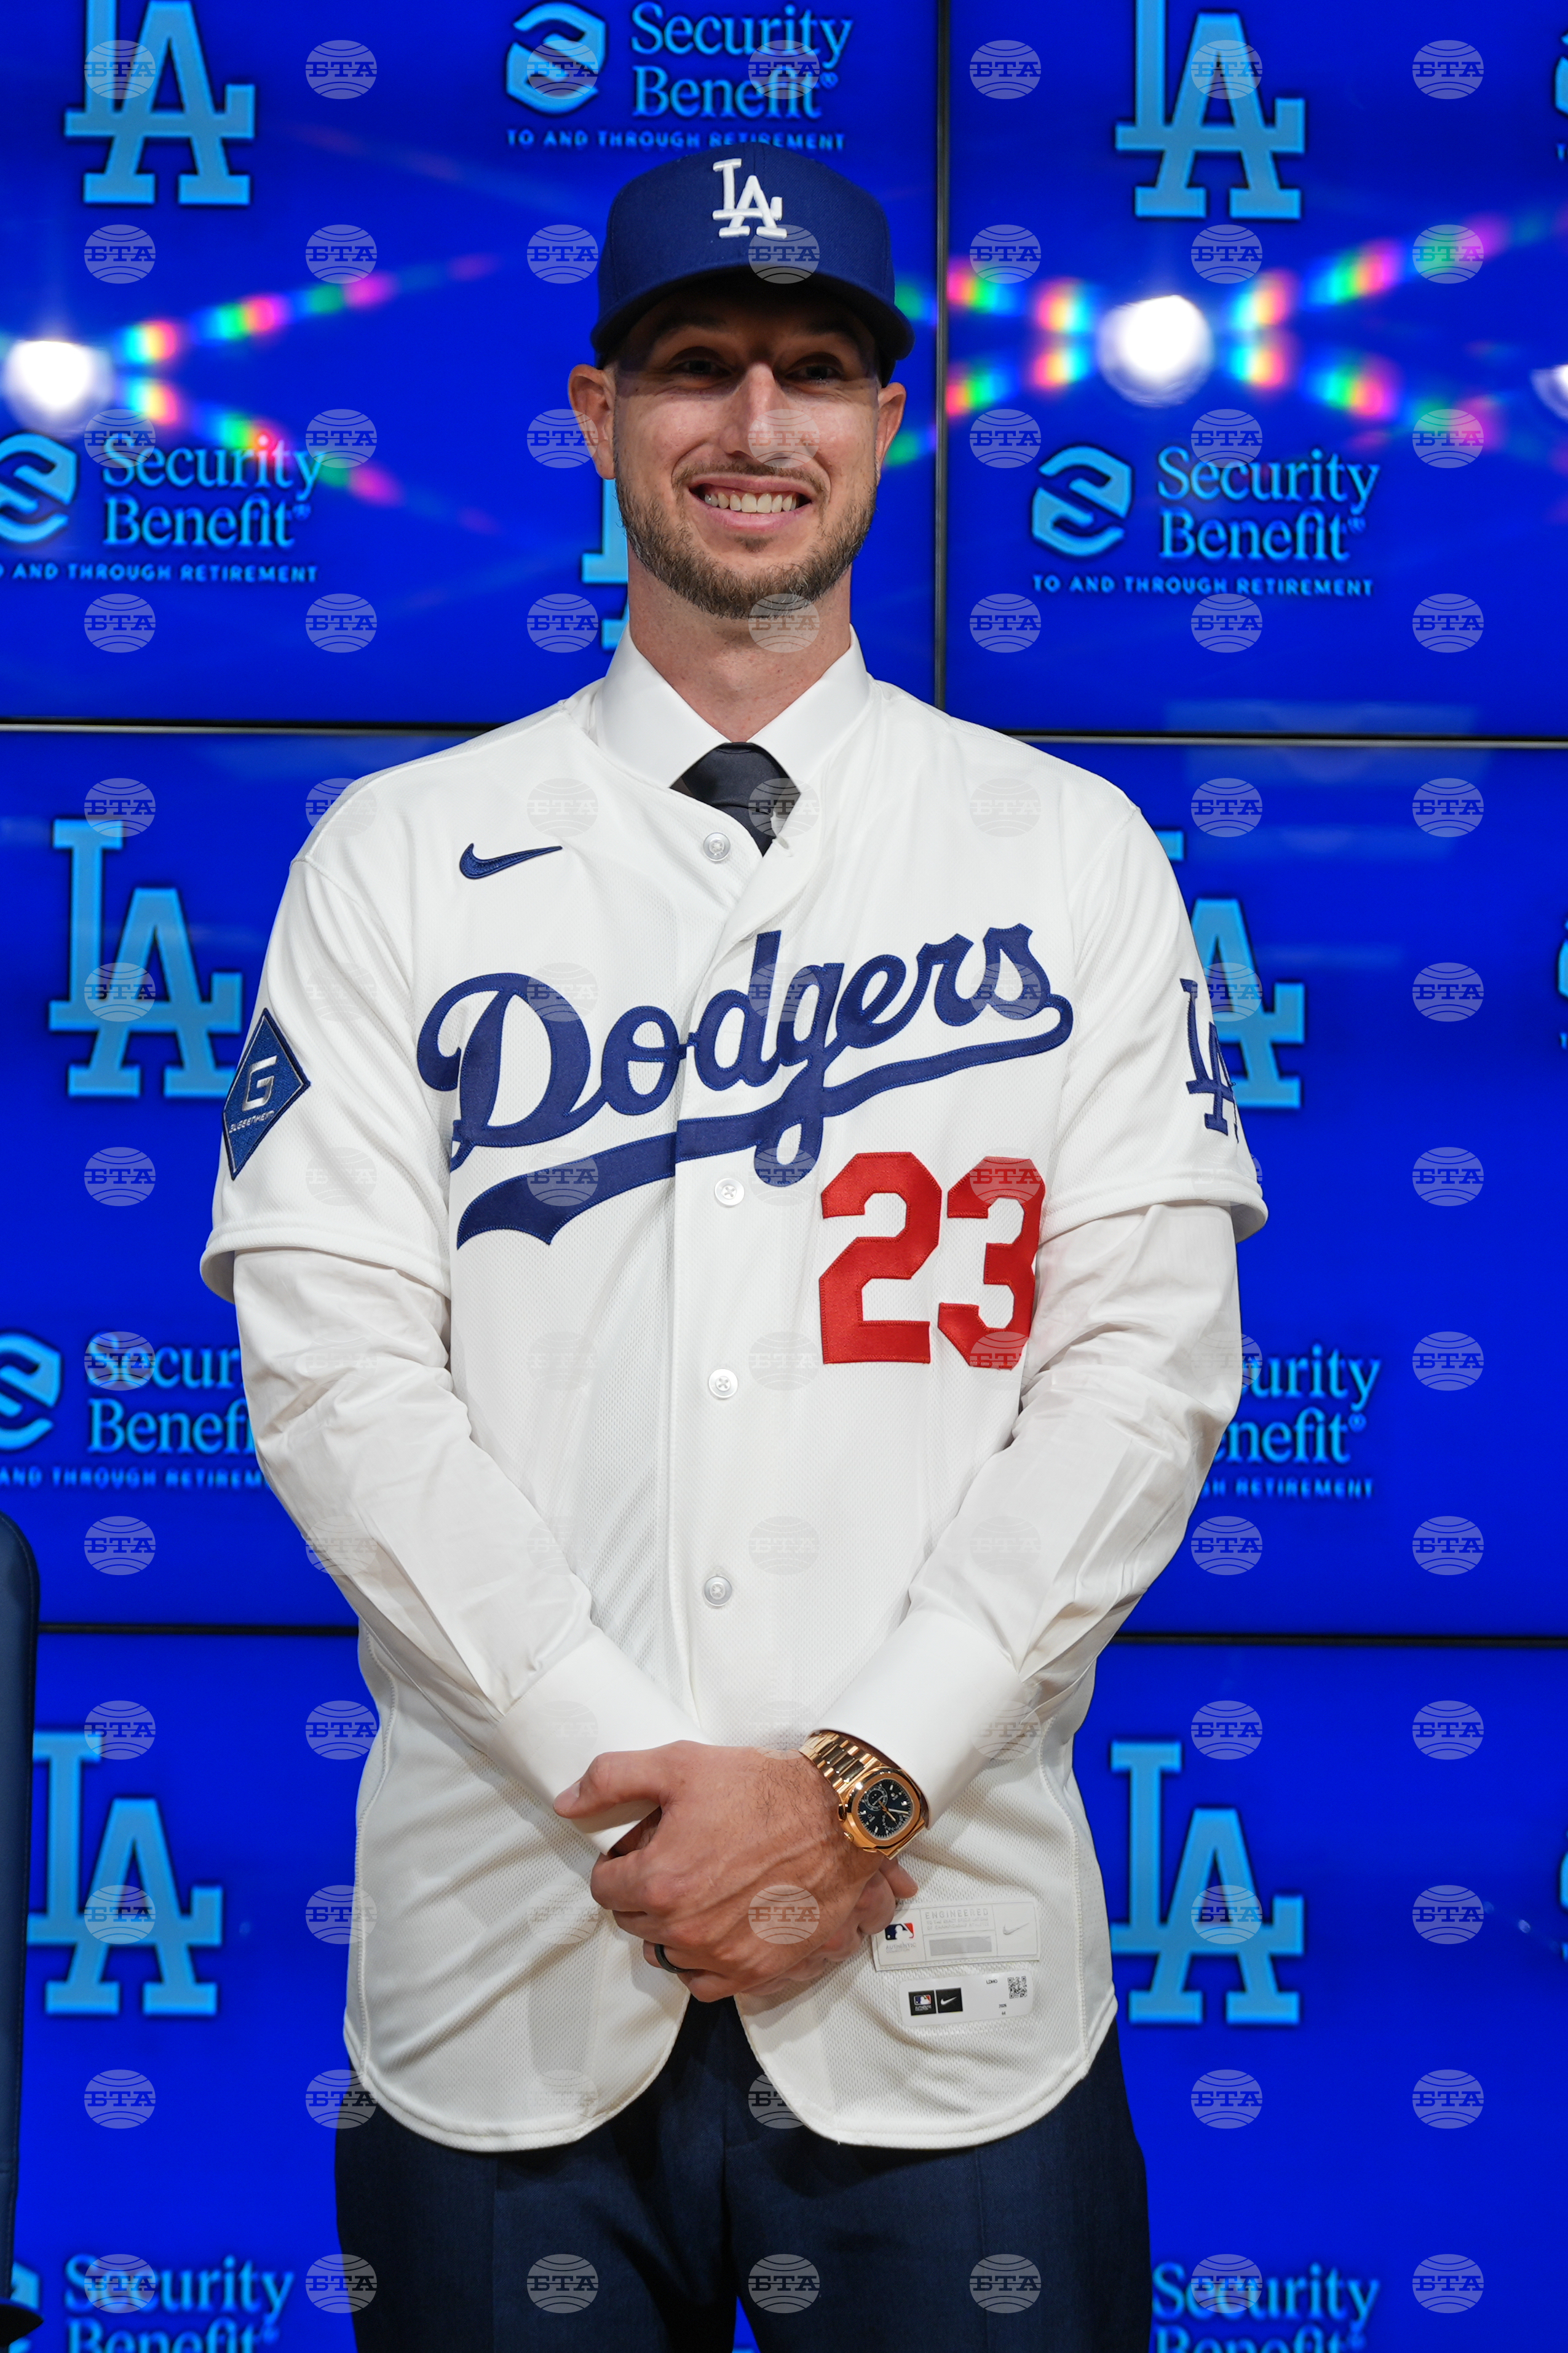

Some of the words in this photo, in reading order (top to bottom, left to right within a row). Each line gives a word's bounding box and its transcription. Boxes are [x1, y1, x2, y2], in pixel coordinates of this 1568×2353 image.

[631, 1, 853, 68] Security
[65, 0, 255, 205] LA
[1115, 0, 1305, 219] LA
[507, 129, 534, 149] TO
[543, 130, 588, 150] AND
[598, 130, 700, 150] THROUGH
[713, 158, 787, 239] LA
[102, 432, 326, 501] Security
[1157, 446, 1380, 515] Security
[12, 563, 58, 581] AND
[67, 563, 172, 582] THROUGH
[180, 564, 318, 583] RETIREMENT
[1033, 574, 1061, 593] TO
[1069, 574, 1115, 593] AND
[1124, 576, 1228, 595] THROUGH
[1236, 577, 1374, 597] RETIREMENT
[49, 819, 242, 1098] LA
[416, 924, 1073, 1188] Dodgers
[819, 1151, 1045, 1370] 23
[87, 1331, 242, 1389] Secur
[1242, 1343, 1382, 1412] urity
[27, 1730, 223, 2014] LA
[1111, 1740, 1304, 2024] LA
[925, 1908, 988, 1919] ENGINEERED
[65, 2253, 295, 2325] Security
[1152, 2262, 1381, 2334] Security
